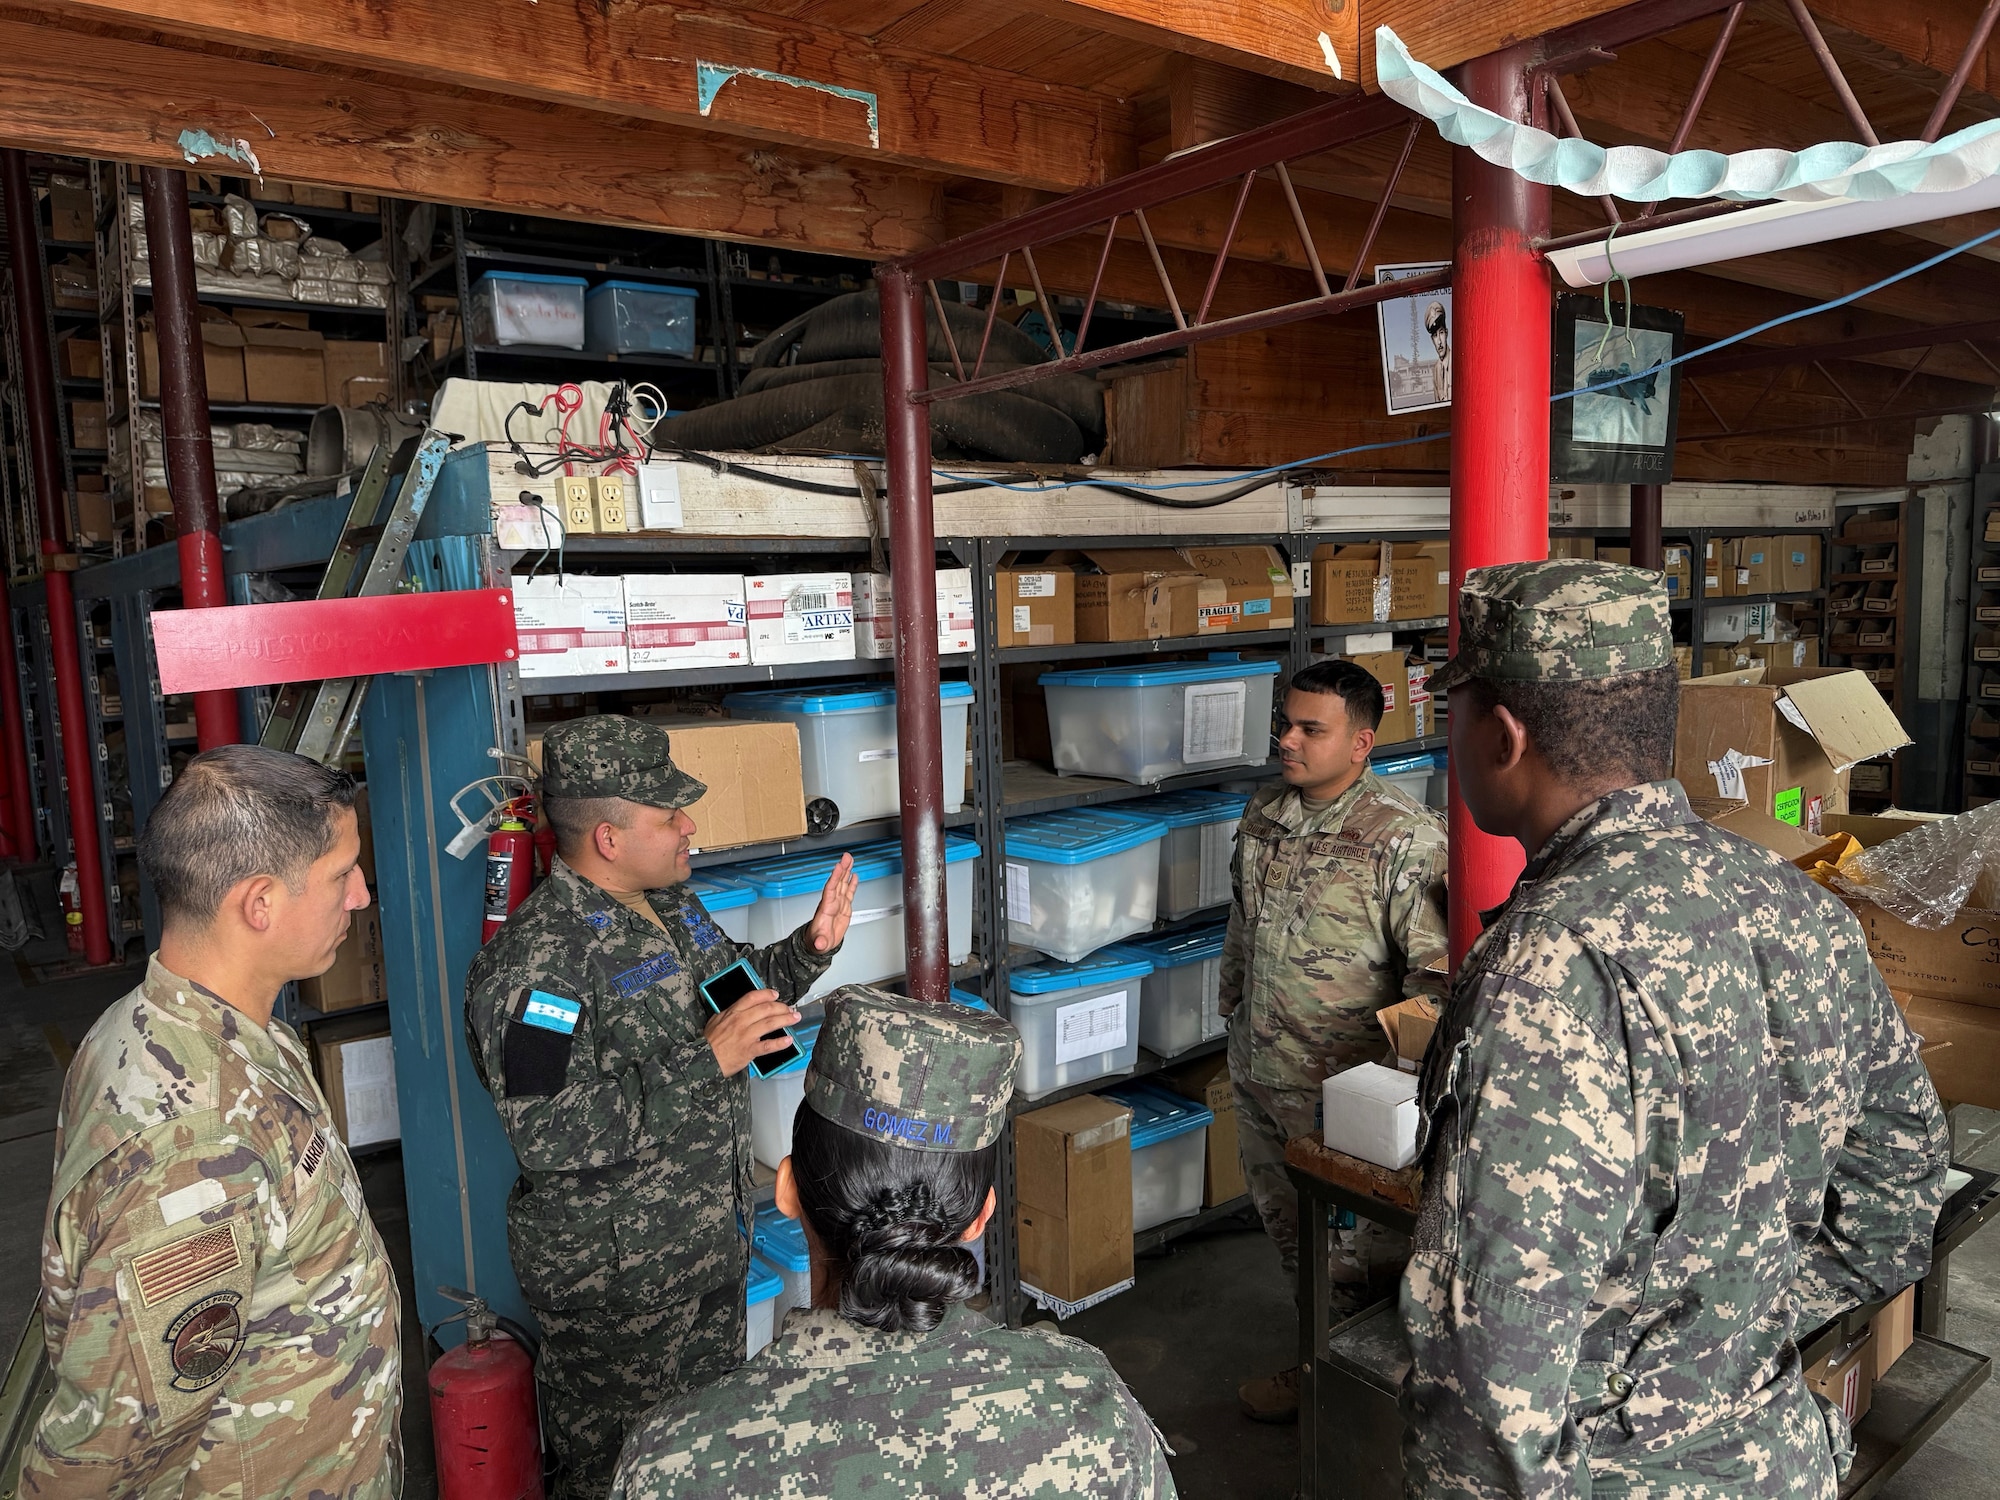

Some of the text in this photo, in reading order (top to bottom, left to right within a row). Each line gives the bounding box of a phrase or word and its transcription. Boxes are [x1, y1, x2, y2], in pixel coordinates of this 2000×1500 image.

[1195, 554, 1227, 569] Box
[1303, 569, 1309, 589] E
[1199, 605, 1238, 617] FRAGILE
[802, 612, 852, 628] ARTEX
[957, 640, 968, 648] 3M
[728, 651, 741, 659] 3M
[604, 659, 619, 668] 3M
[620, 956, 673, 991] MIDENCE
[1885, 967, 1897, 975] BY
[1902, 970, 1948, 982] TEXTRON
[863, 1107, 954, 1145] GOMEZ M.
